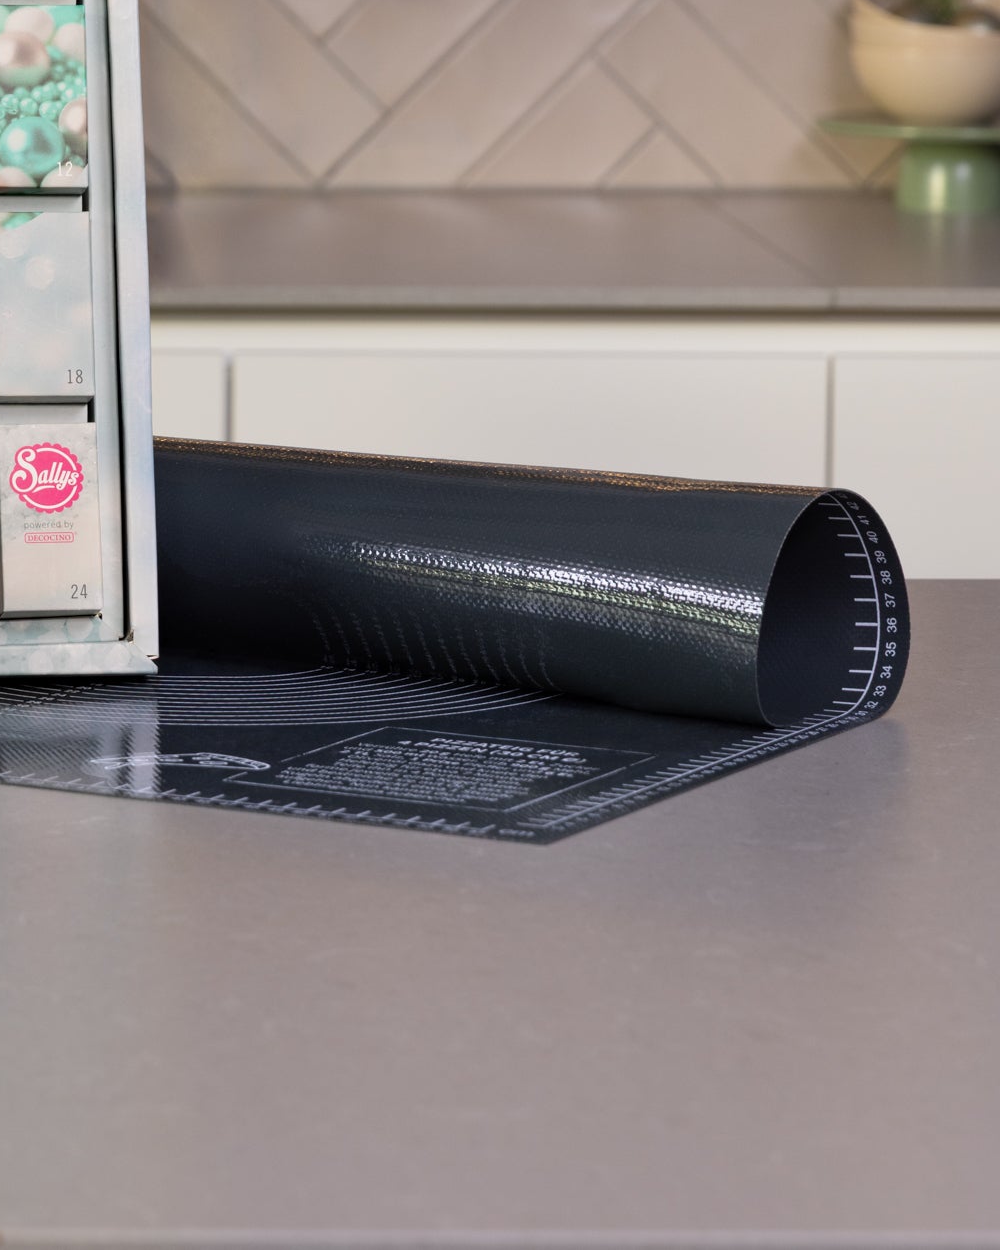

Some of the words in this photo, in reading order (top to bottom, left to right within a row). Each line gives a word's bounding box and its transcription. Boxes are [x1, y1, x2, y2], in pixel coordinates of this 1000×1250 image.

[56, 161, 73, 177] 12
[67, 369, 84, 384] 18
[12, 448, 80, 493] Sallys
[23, 520, 62, 530] powered
[63, 519, 75, 530] by
[27, 534, 72, 542] DECOCINO
[866, 530, 879, 544] 40
[874, 550, 888, 564] 39
[880, 570, 893, 585] 38
[70, 584, 88, 599] 24
[884, 593, 896, 608] 37
[886, 617, 897, 633] 36
[885, 641, 897, 657] 35
[880, 665, 893, 679] 34
[873, 685, 887, 697] 33
[864, 700, 879, 709] 32
